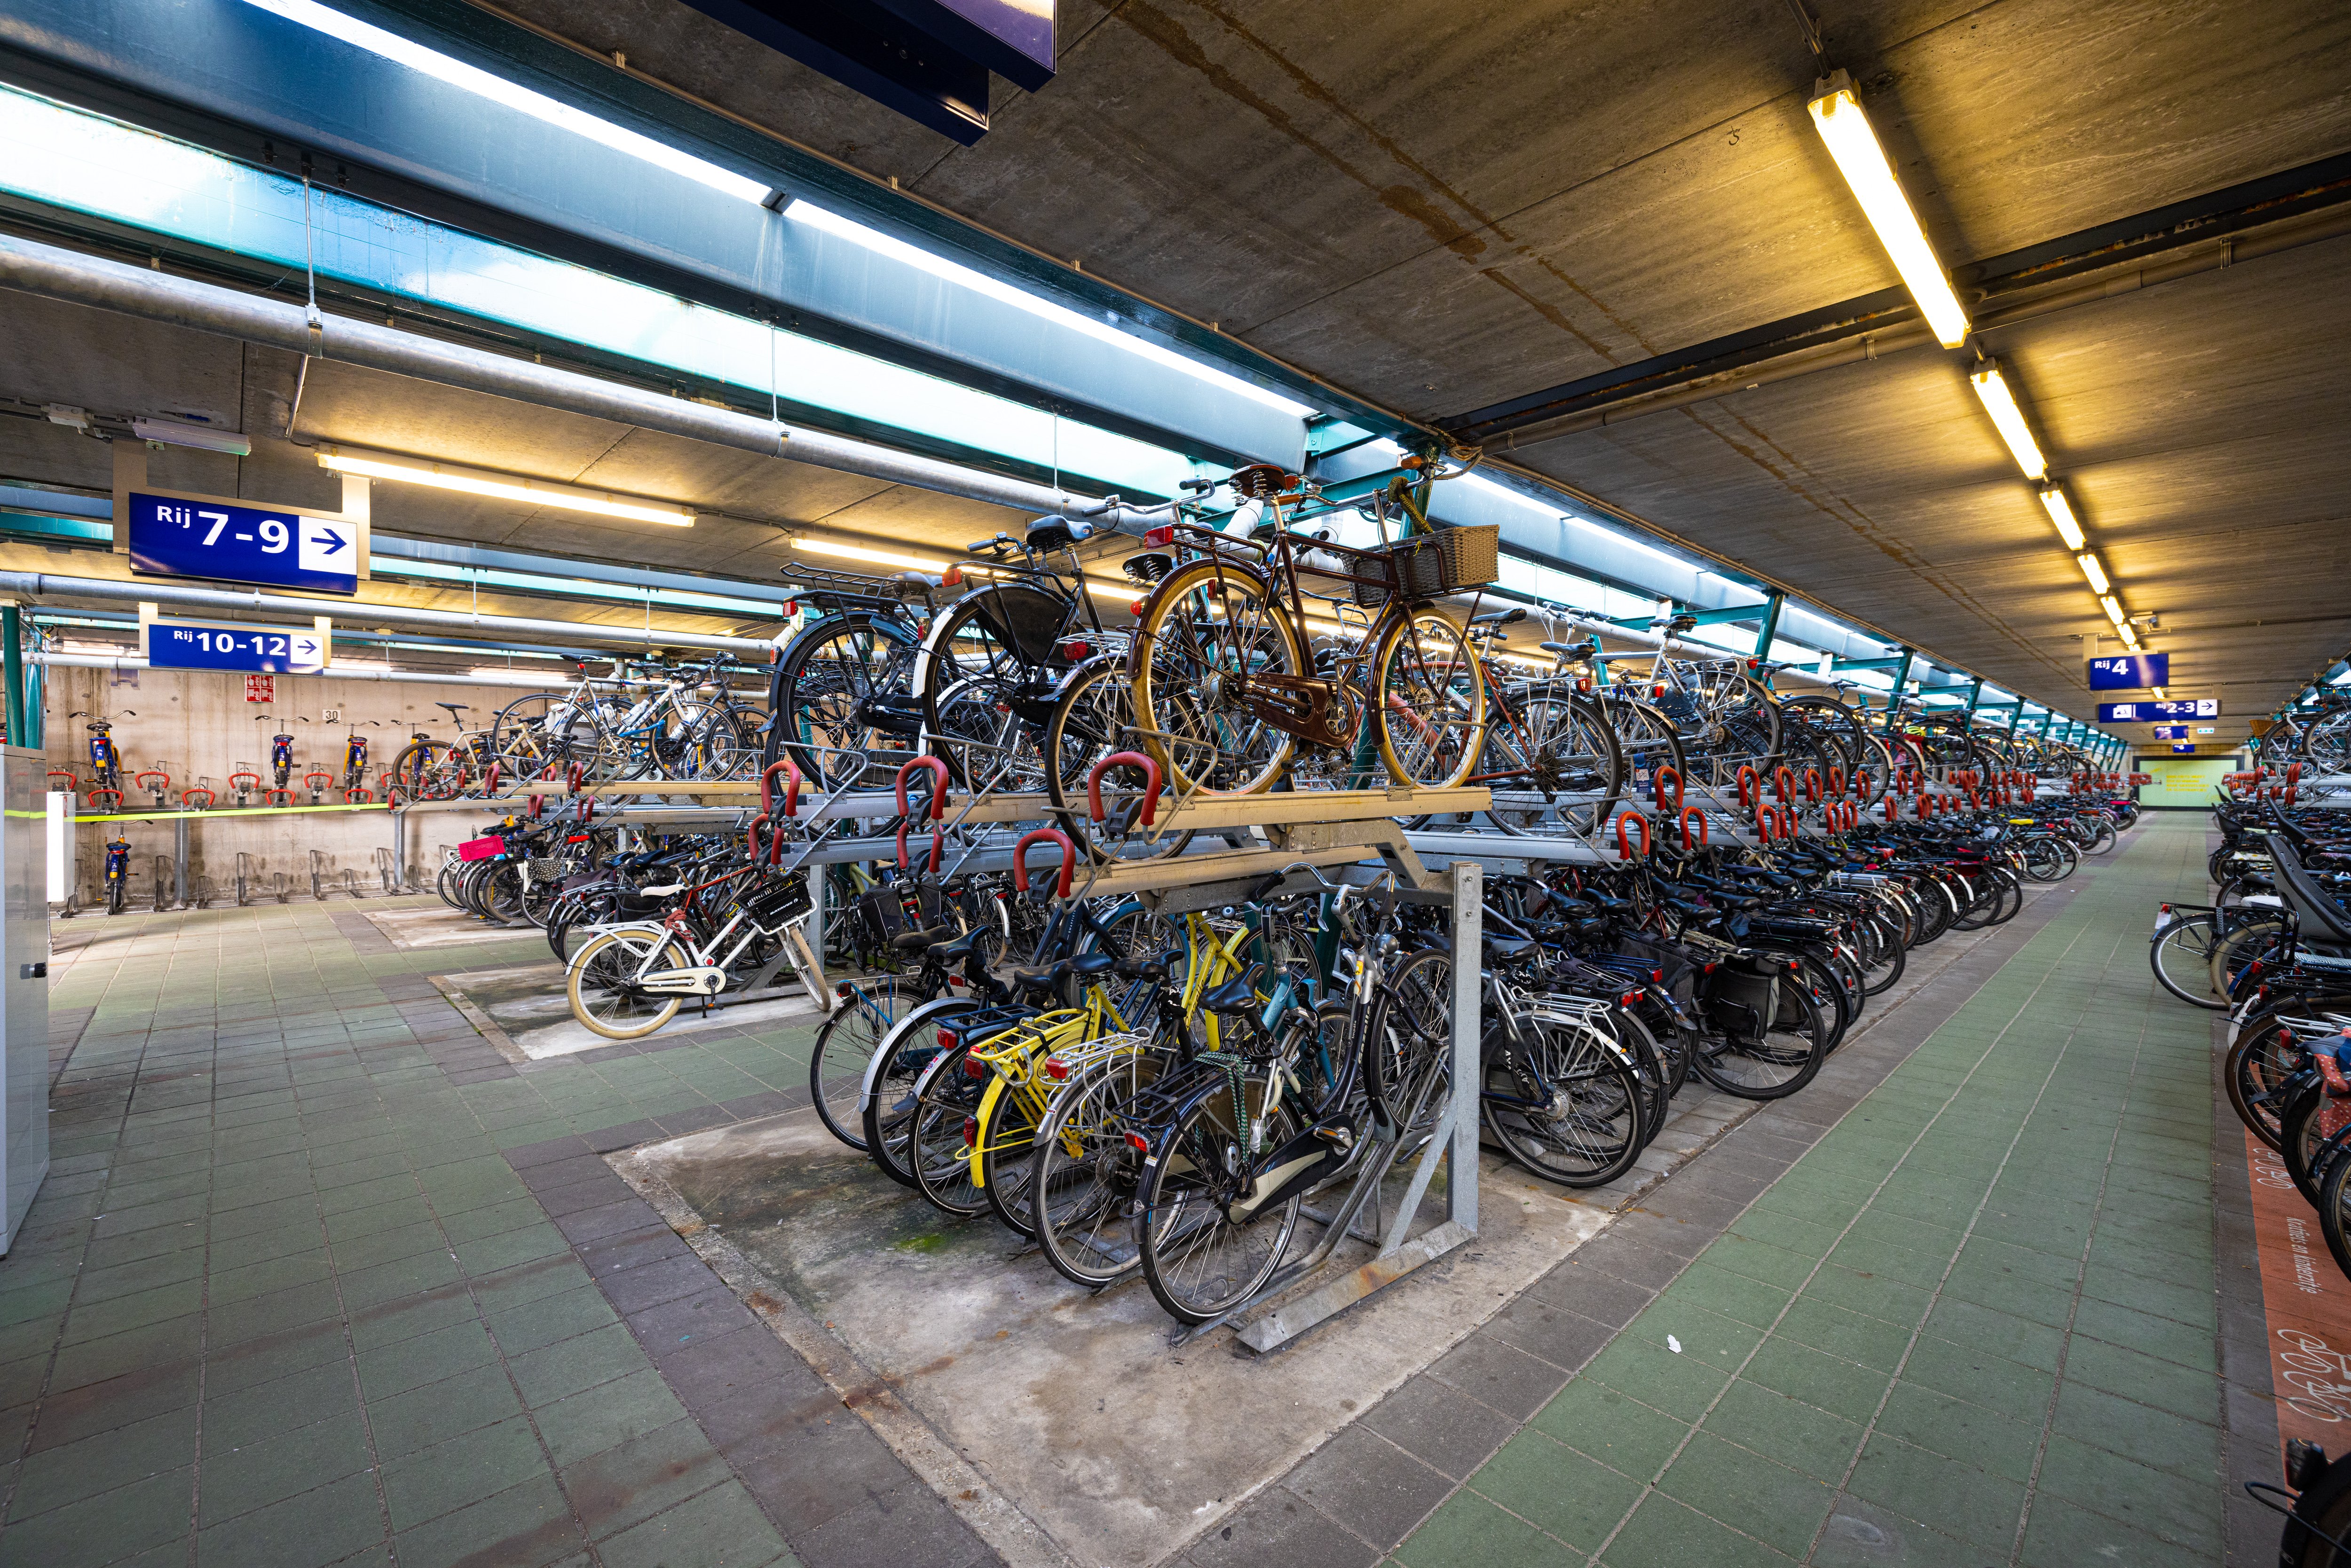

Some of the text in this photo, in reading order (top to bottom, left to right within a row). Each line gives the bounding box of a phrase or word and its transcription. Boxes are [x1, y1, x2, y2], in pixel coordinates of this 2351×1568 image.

[1399, 494, 1426, 524] Bruinewoud
[157, 505, 289, 554] Rij 7-9
[1382, 602, 1393, 618] ACHIELLE
[174, 630, 286, 656] Rij 10-12
[2095, 659, 2129, 675] Rij 4
[326, 710, 338, 719] 30
[2167, 702, 2195, 713] 2-3
[770, 901, 793, 915] BATAVUS
[1185, 979, 1205, 1028] Gazelle
[1358, 1005, 1371, 1064] Gazelle
[1151, 1168, 1162, 1201] MARATHON
[2291, 1244, 2308, 1253] en
[2293, 1254, 2323, 1294] kinderzitje
